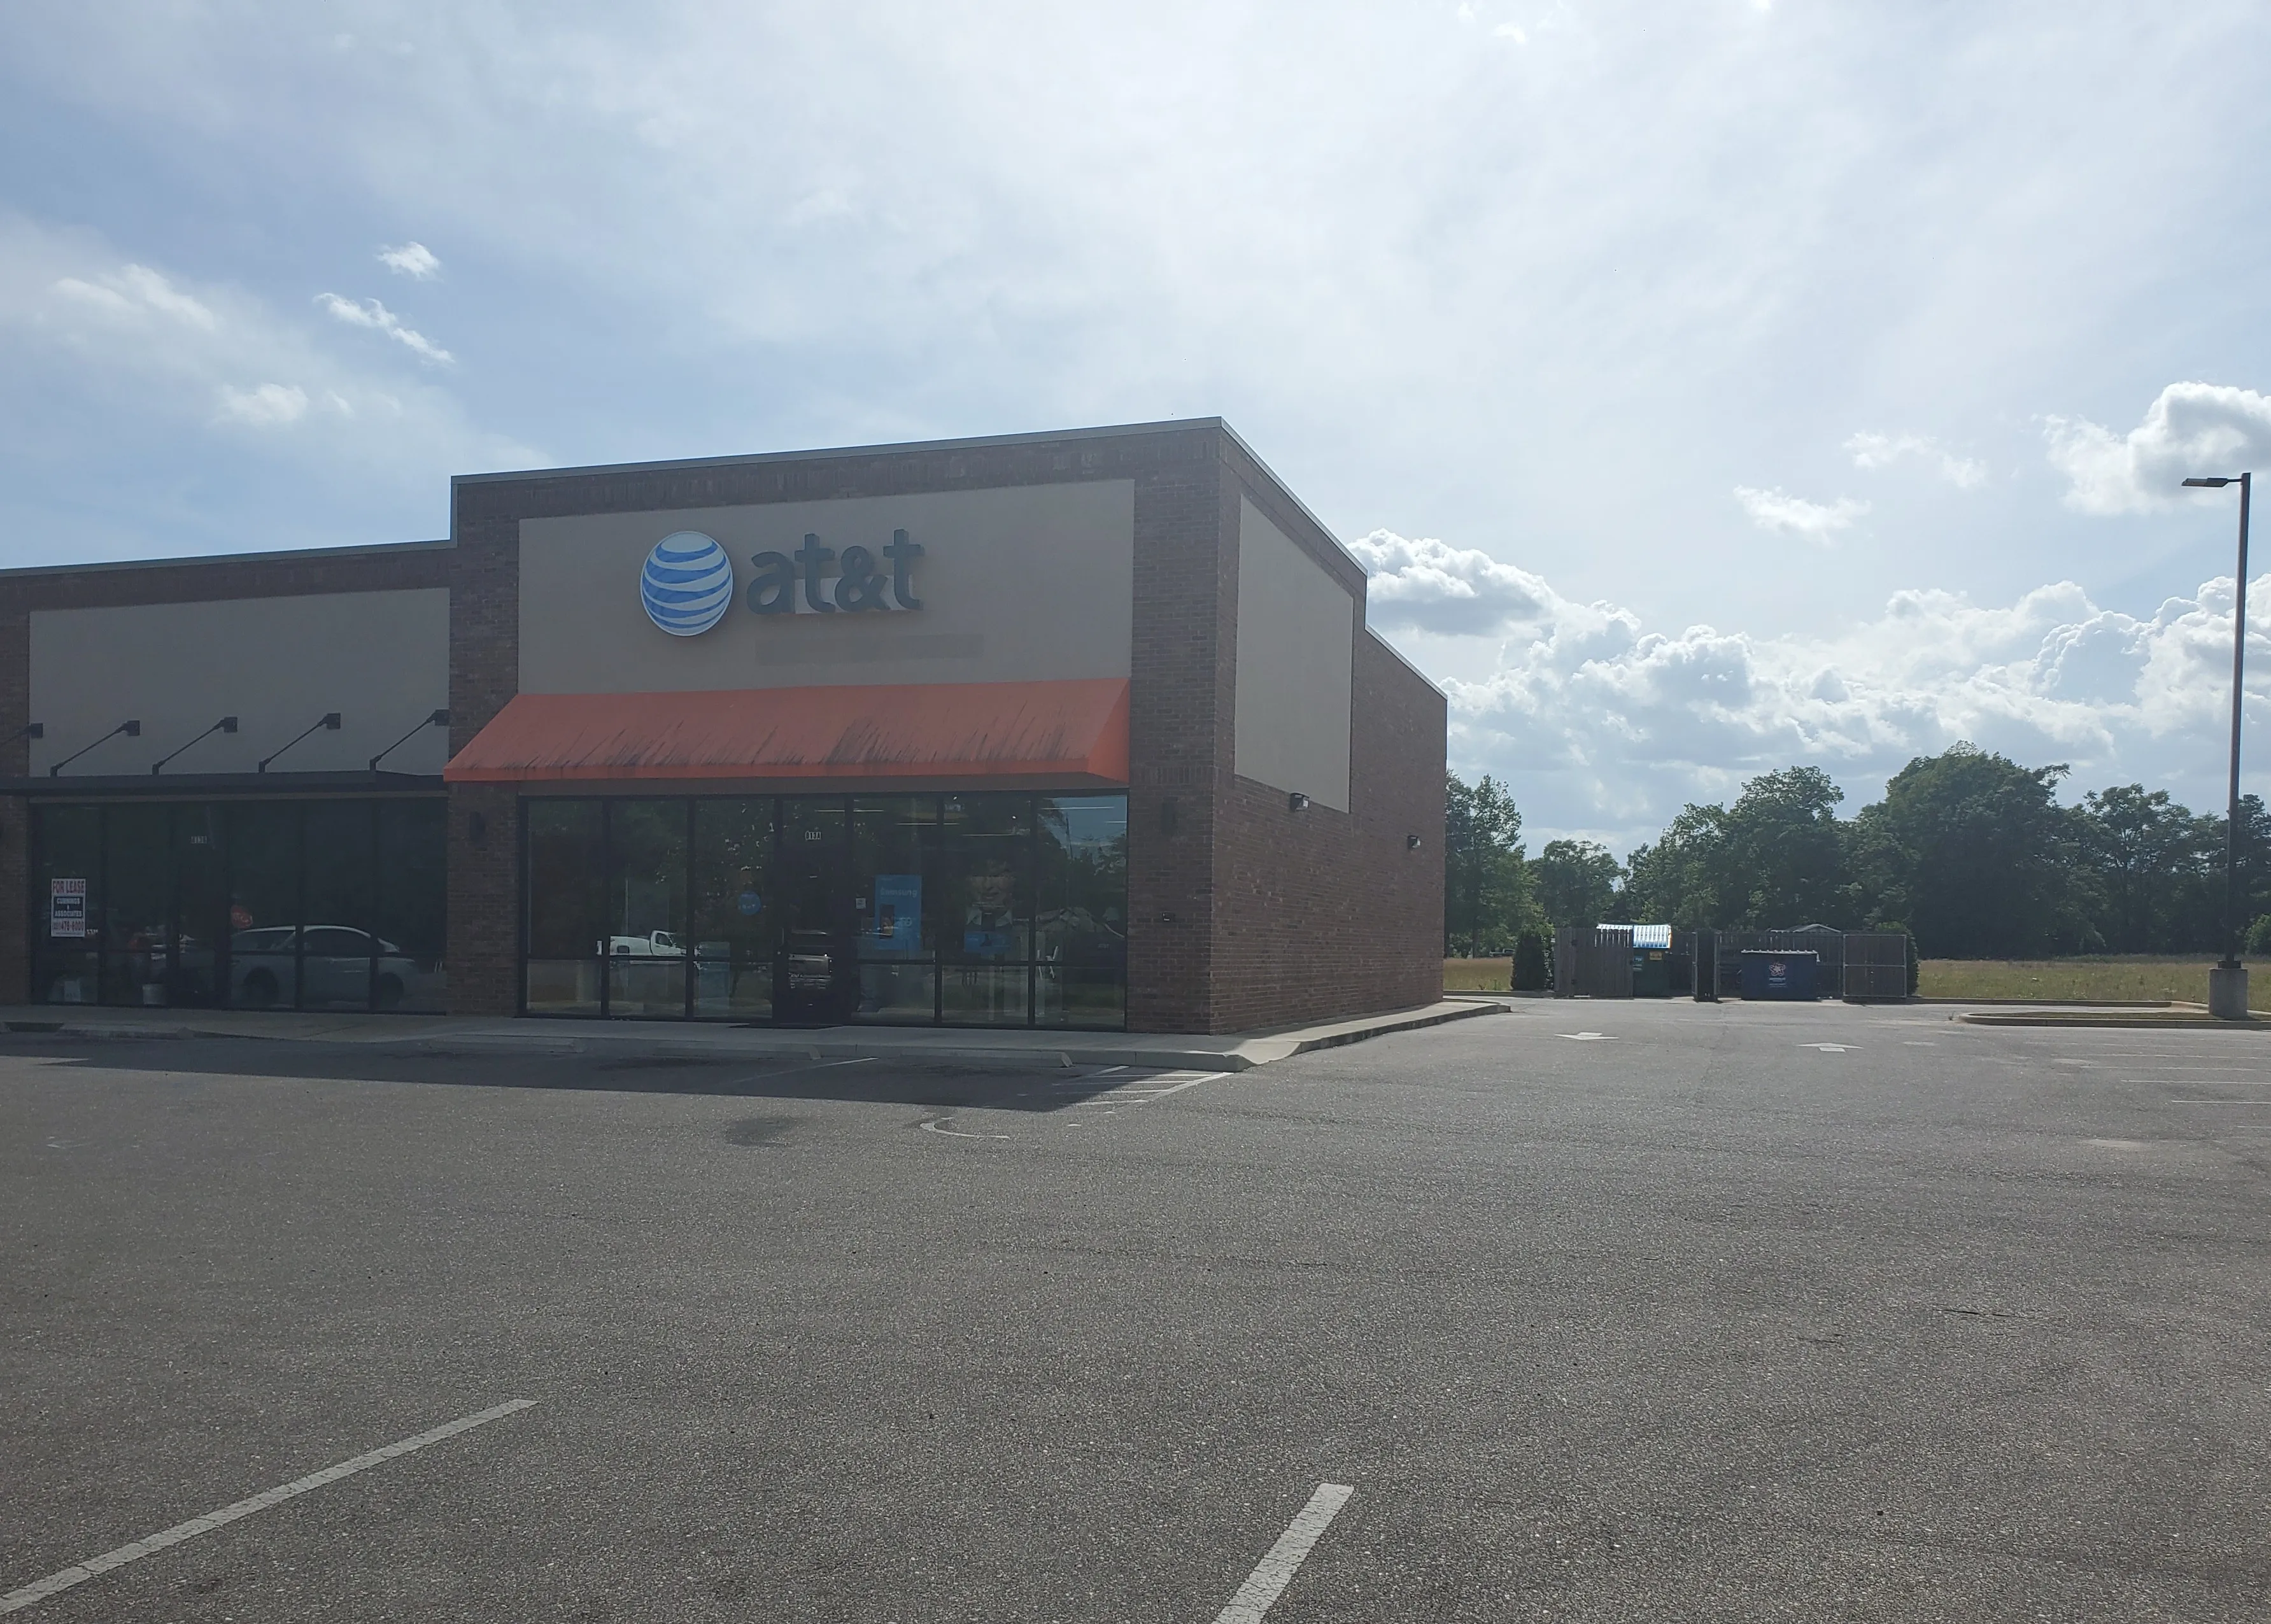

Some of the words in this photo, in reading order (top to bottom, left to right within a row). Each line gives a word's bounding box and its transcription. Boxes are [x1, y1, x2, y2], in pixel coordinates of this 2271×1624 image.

[746, 528, 925, 615] at&t
[53, 880, 64, 893] FOR
[66, 880, 85, 893] LEASE
[880, 888, 918, 898] Samsung
